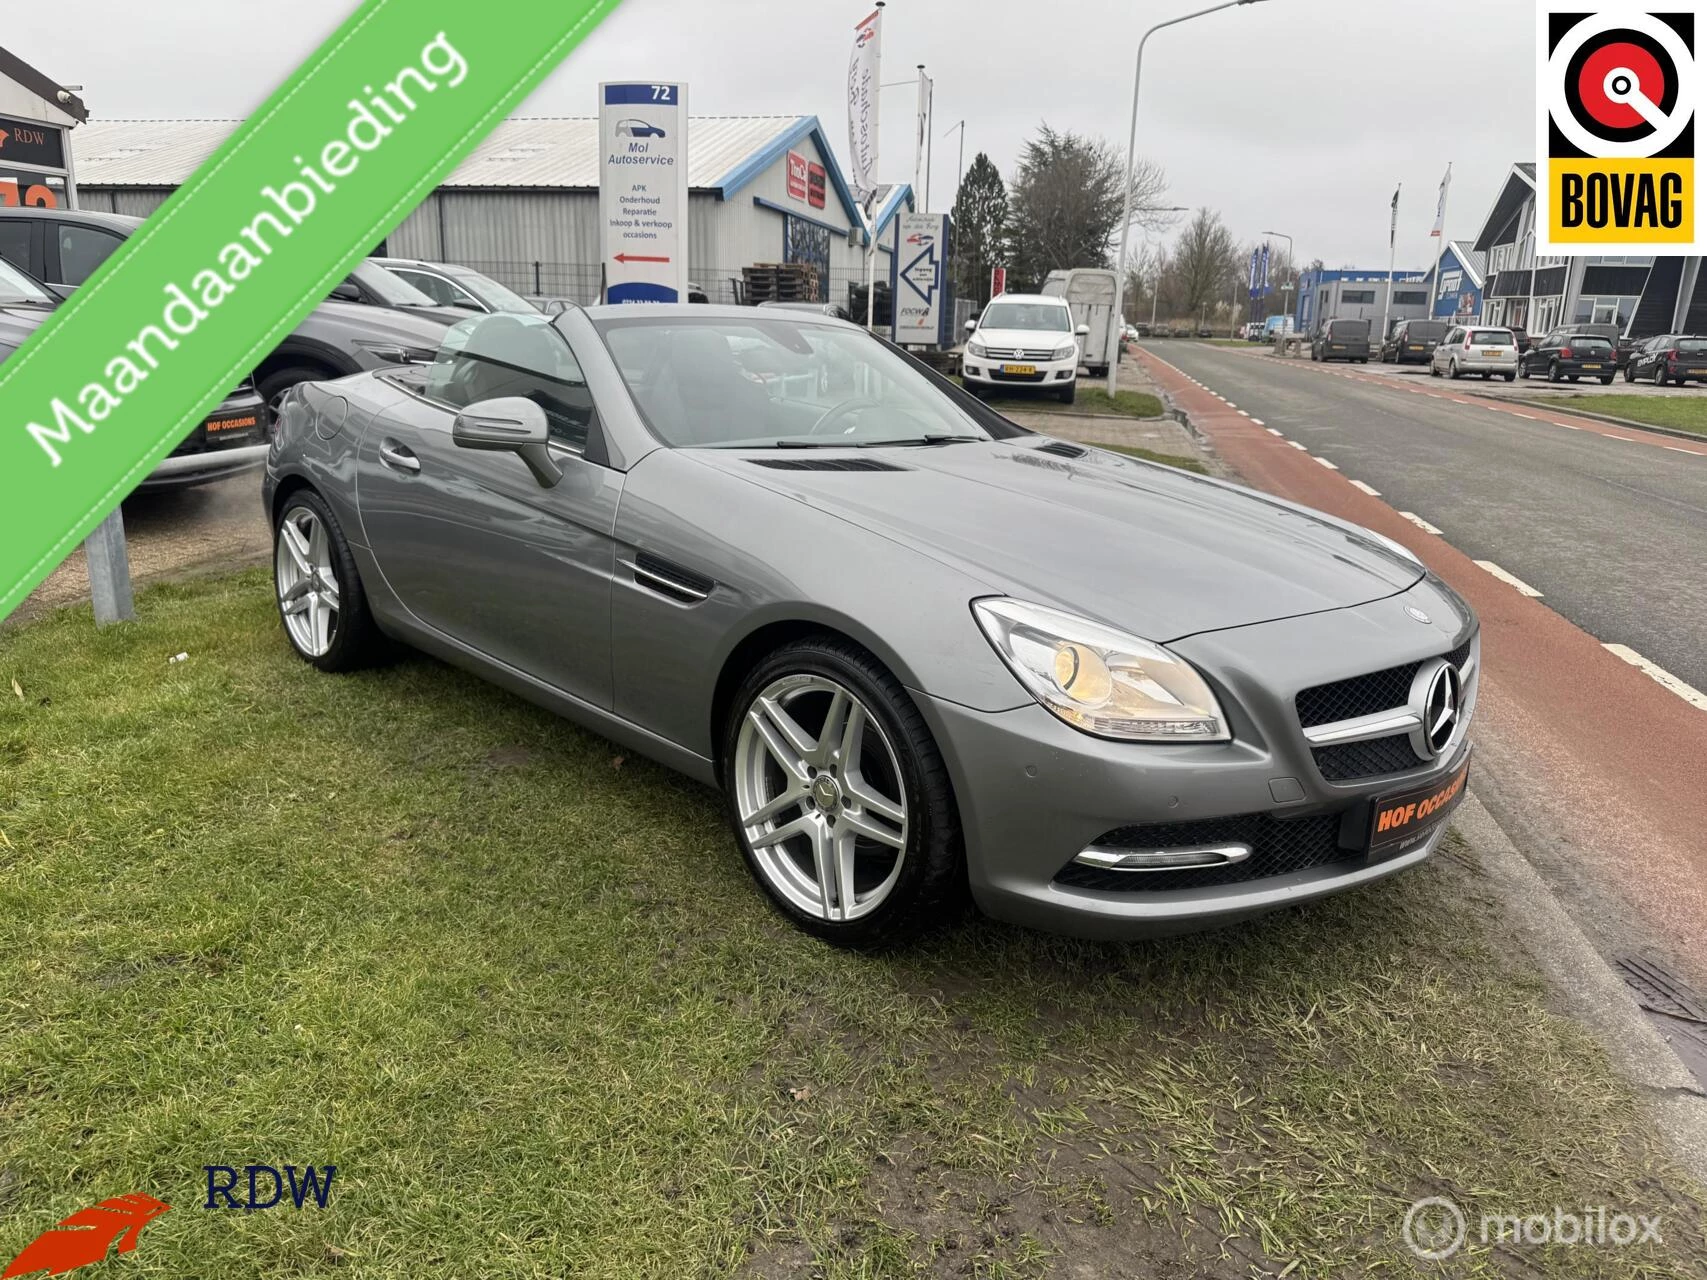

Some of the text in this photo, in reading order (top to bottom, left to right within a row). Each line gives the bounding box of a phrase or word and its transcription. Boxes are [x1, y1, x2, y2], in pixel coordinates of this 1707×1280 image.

[651, 85, 671, 100] 72
[14, 127, 45, 145] RDW
[628, 142, 649, 153] Mol
[608, 154, 674, 166] Autoservice
[631, 184, 647, 192] APK
[619, 196, 661, 205] Onderhoud
[622, 208, 657, 216] Reparatie
[609, 219, 633, 228] Inkoop
[641, 220, 673, 229] verkoop
[623, 231, 658, 240] occasions
[207, 421, 221, 432] HOF
[1377, 803, 1416, 833] HOF
